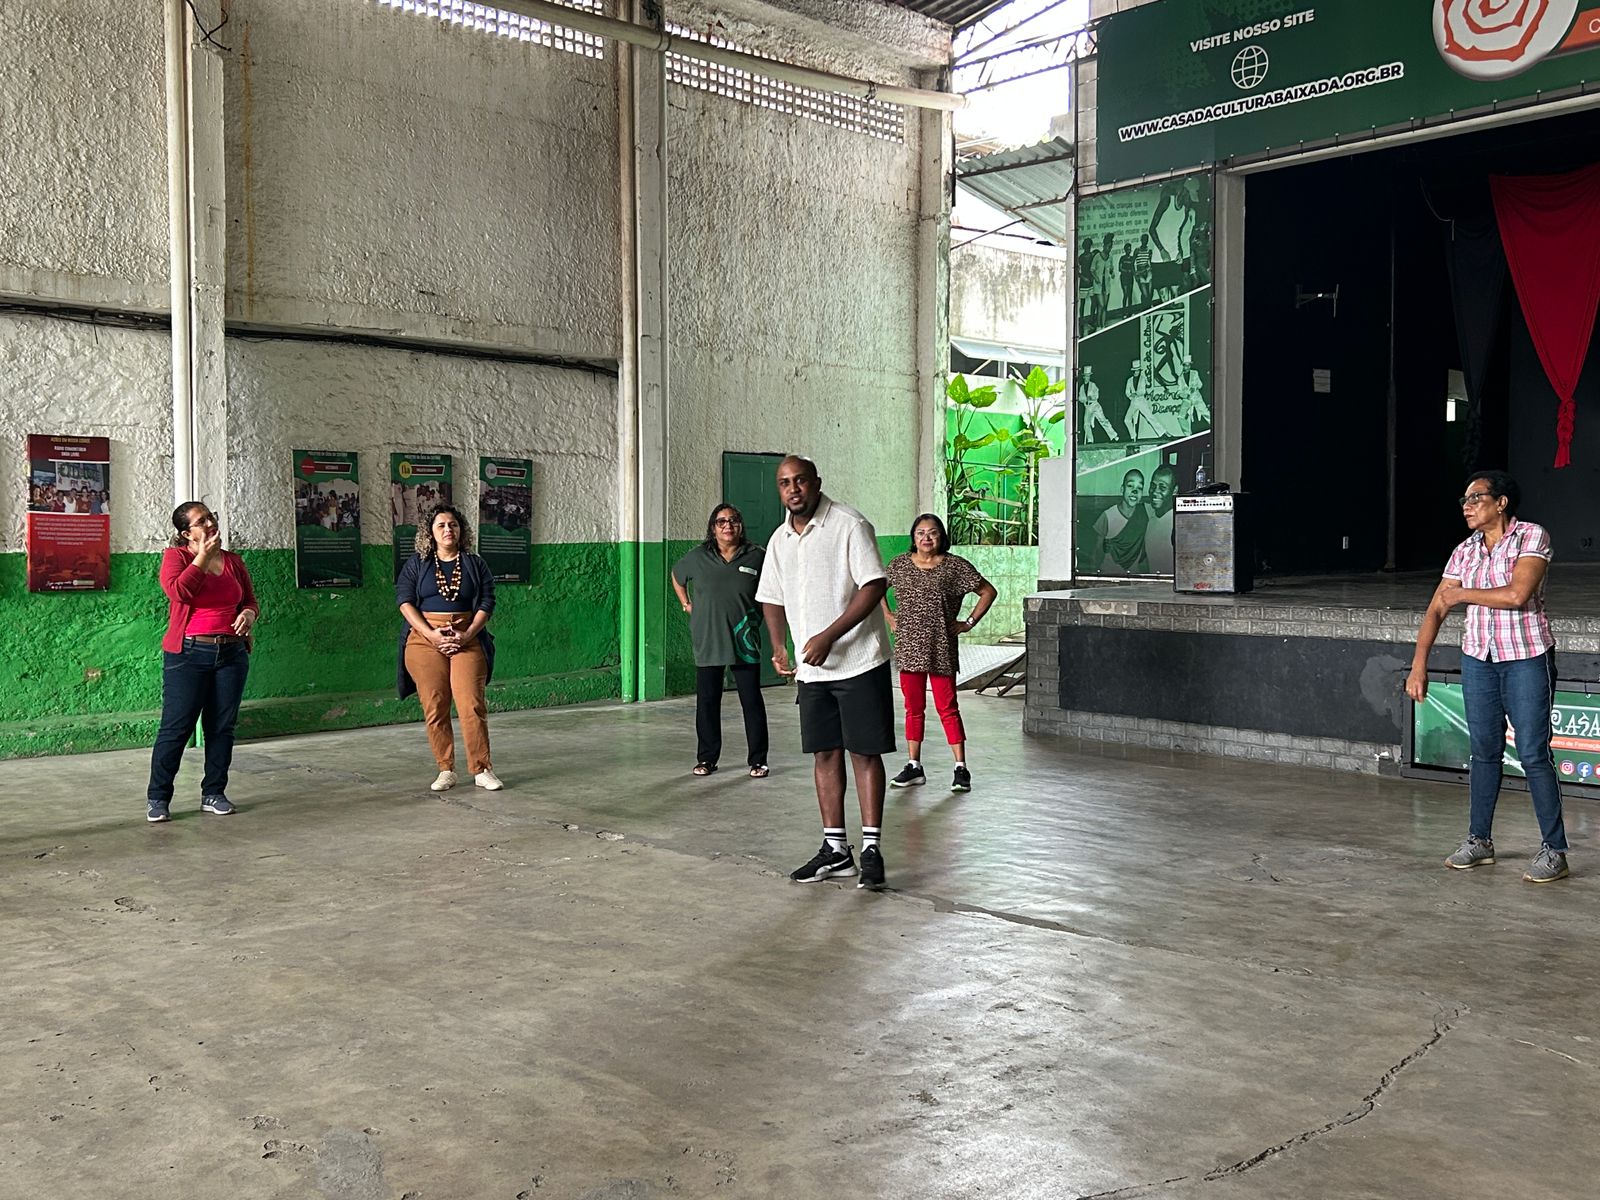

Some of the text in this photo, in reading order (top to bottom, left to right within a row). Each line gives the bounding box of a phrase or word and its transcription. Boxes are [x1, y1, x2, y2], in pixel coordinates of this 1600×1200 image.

[1190, 9, 1315, 53] VISITE NOSSO SITE
[1119, 62, 1403, 142] WWW.CASADACULTURABAIXADA.ORG.BR
